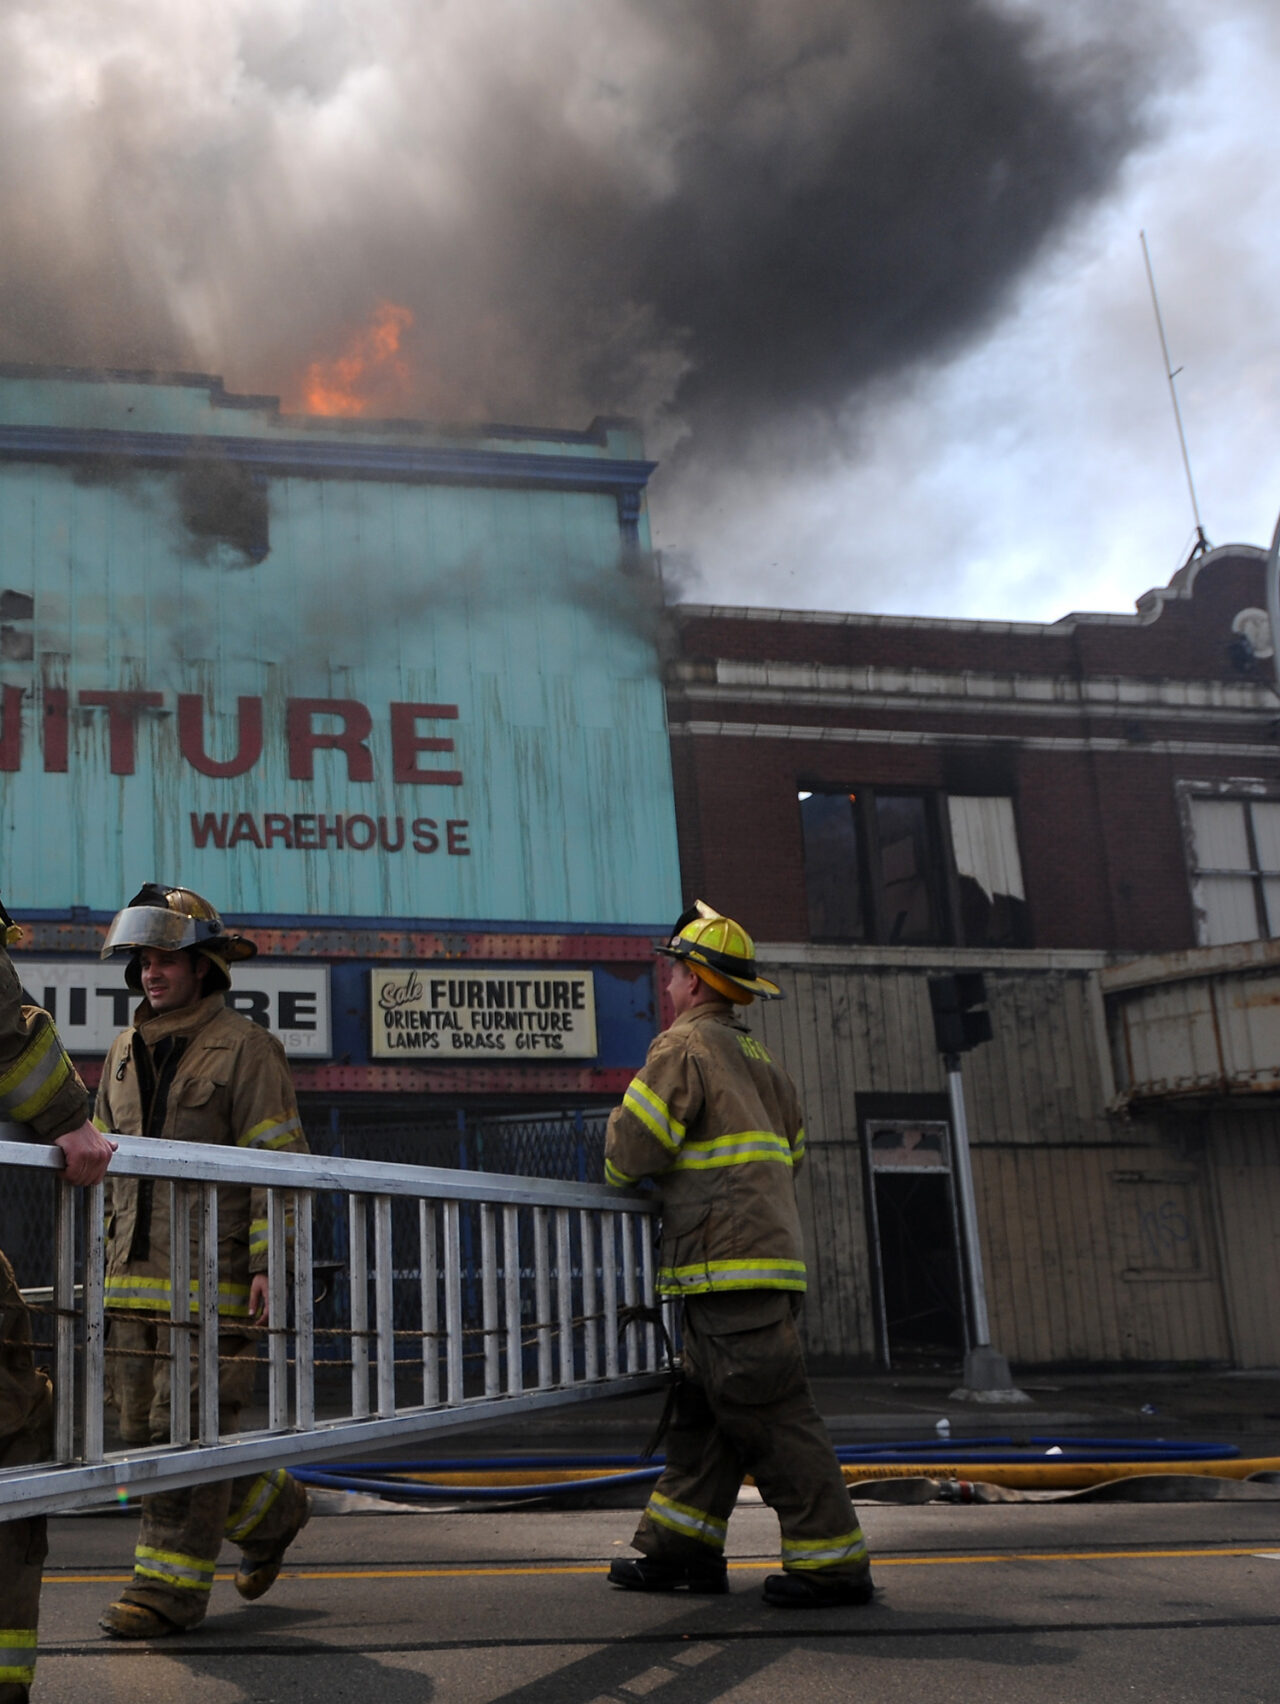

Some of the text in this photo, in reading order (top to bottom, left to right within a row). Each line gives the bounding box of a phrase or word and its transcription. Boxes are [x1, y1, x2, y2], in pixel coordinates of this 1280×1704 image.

[190, 812, 470, 856] WAREHOUSE
[378, 970, 586, 1010] Sale FURNITURE
[384, 1009, 574, 1032] ORIENTAL FURNITURE
[387, 1031, 564, 1051] LAMPS BRASS GIFTS
